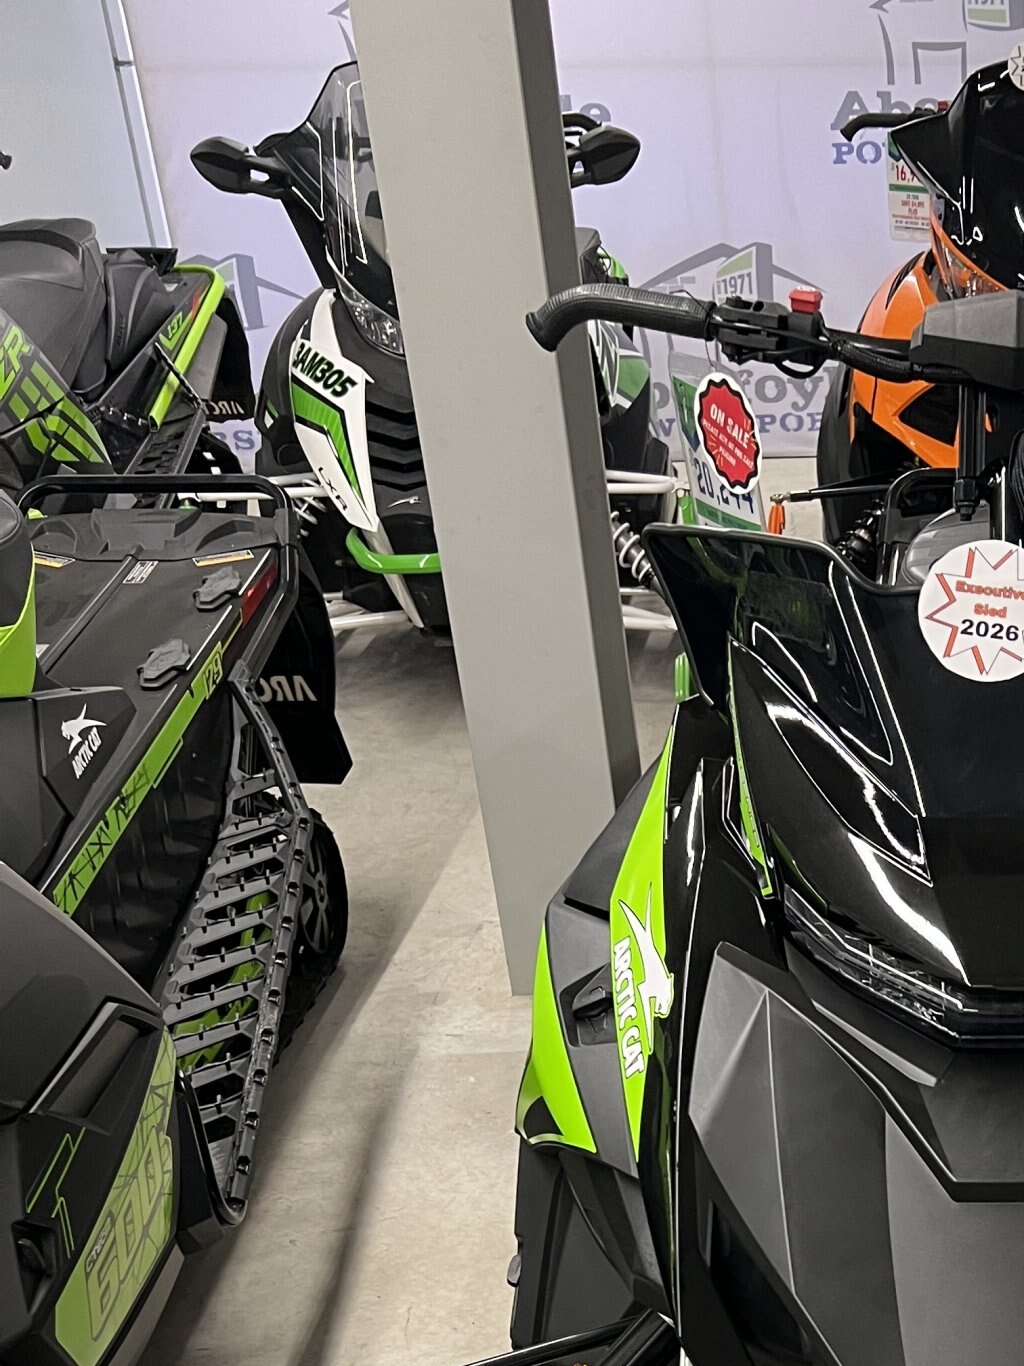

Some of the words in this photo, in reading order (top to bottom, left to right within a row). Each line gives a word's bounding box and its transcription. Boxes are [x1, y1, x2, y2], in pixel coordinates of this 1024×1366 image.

[721, 271, 753, 295] 1971
[710, 403, 726, 428] ON
[727, 416, 750, 448] SALE
[960, 618, 1020, 642] 2026
[973, 603, 1008, 619] Sled
[72, 740, 94, 780] ARCTIC
[87, 726, 102, 752] CAT
[613, 935, 638, 1031] ARCTIC
[620, 1025, 645, 1080] CAT
[86, 1124, 165, 1342] 600
